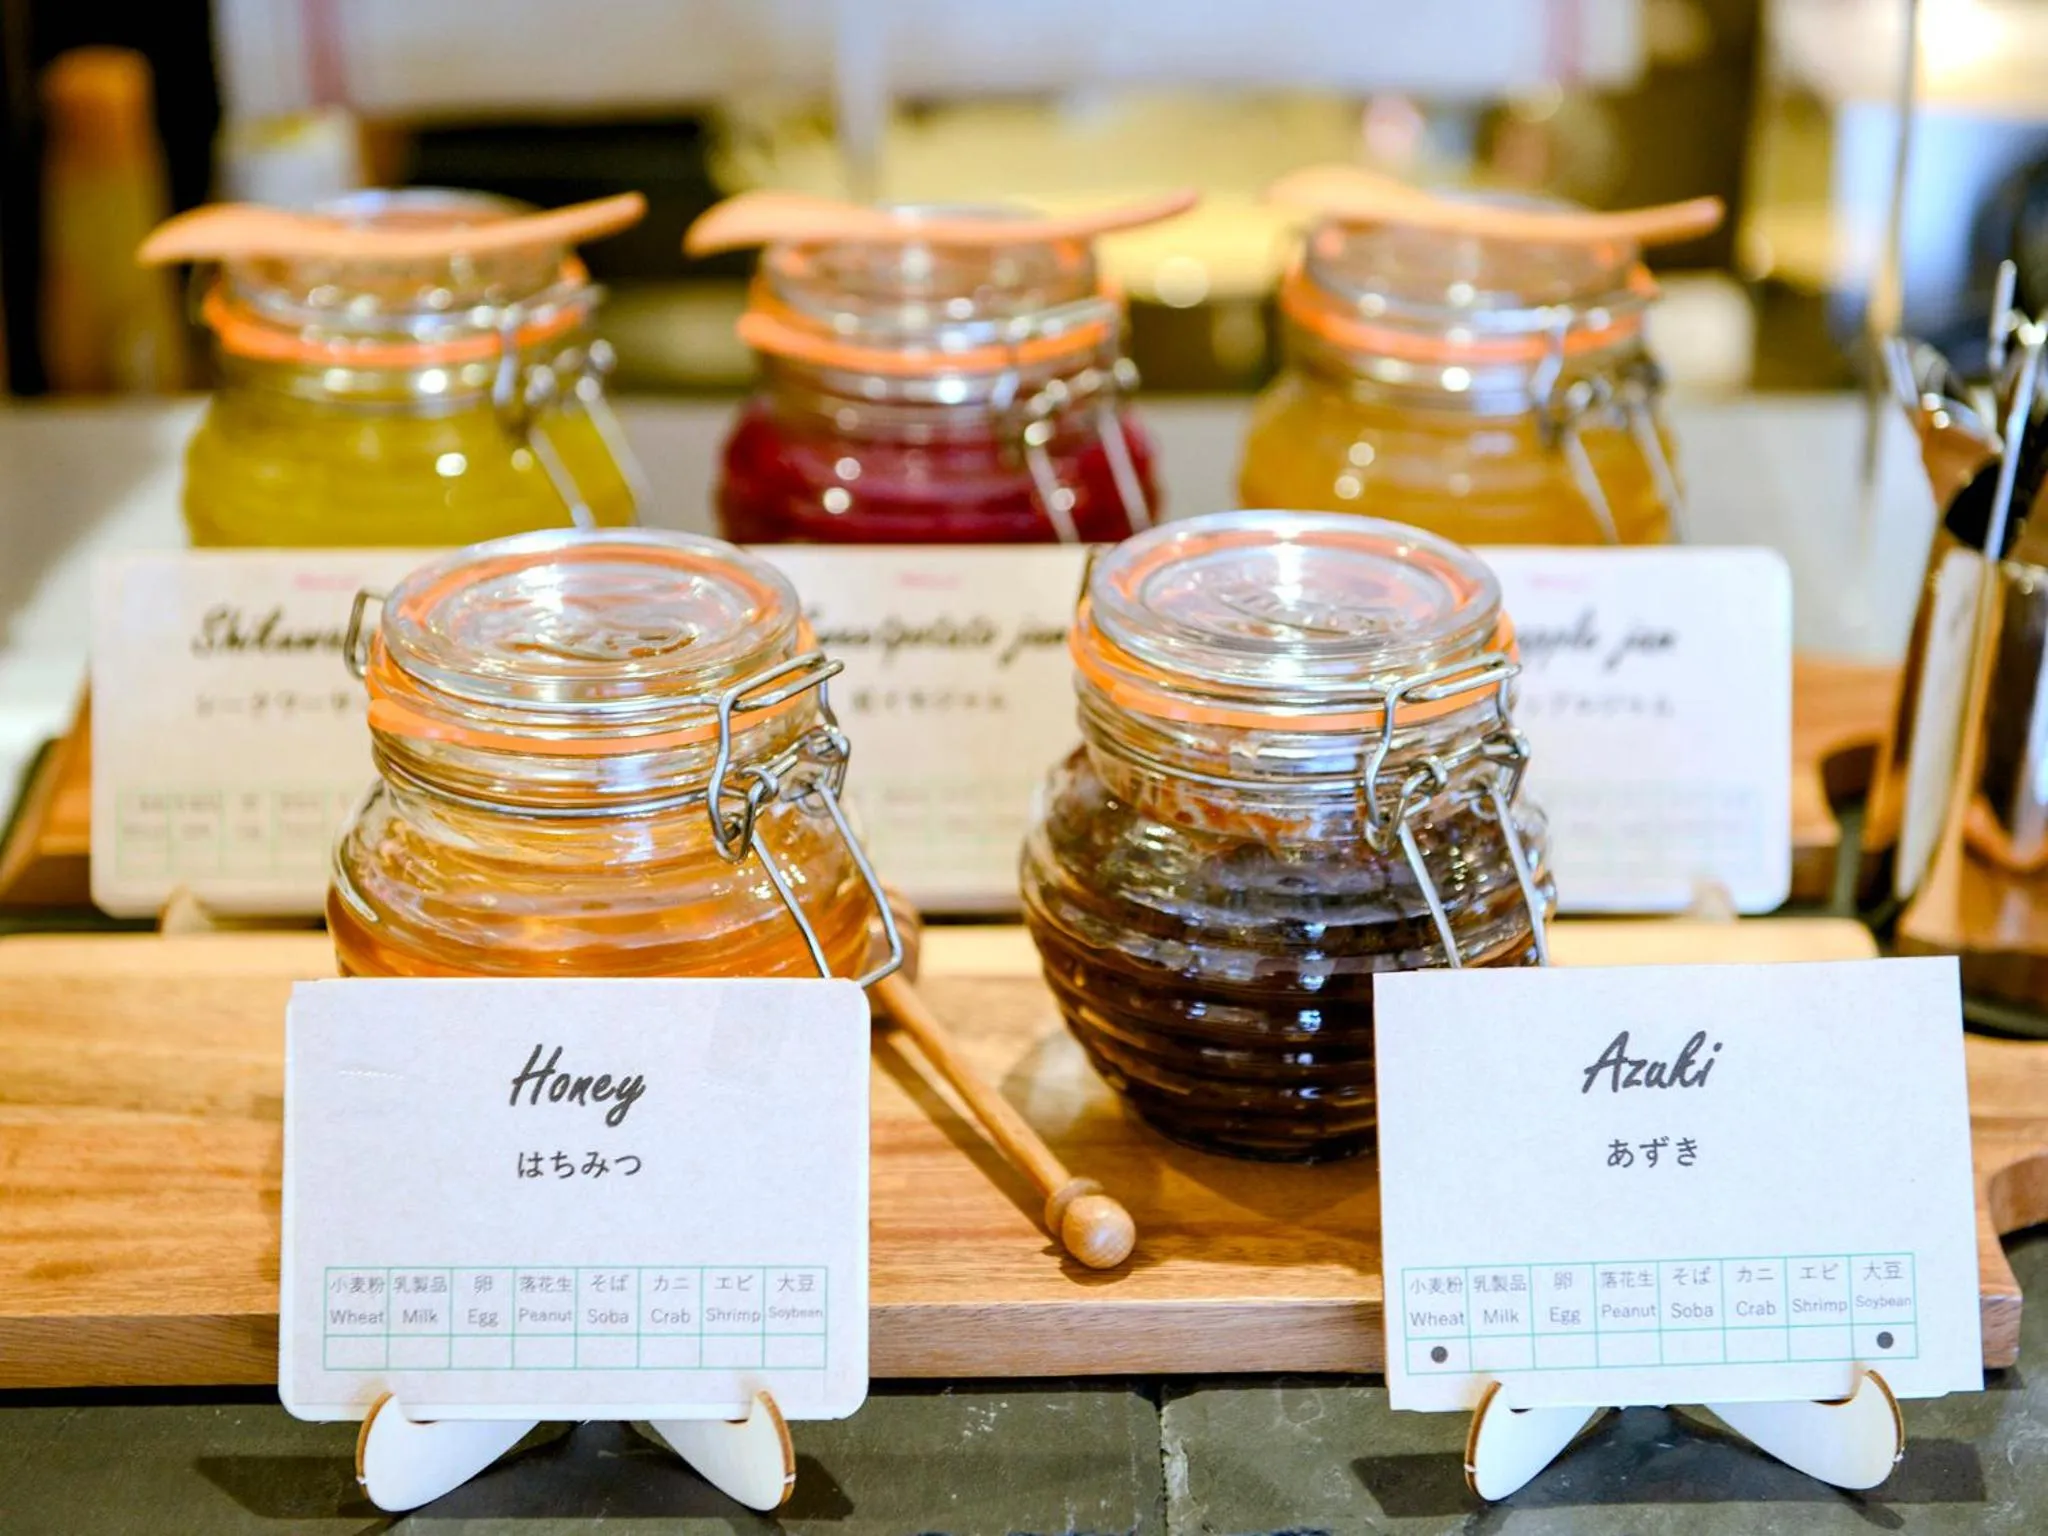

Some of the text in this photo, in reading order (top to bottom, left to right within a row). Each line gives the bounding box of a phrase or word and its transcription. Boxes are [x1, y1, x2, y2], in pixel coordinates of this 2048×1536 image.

[1580, 1029, 1724, 1095] Azuki
[508, 1042, 647, 1129] Honey
[516, 1150, 643, 1180] はちみつ
[1606, 1135, 1699, 1169] あずき
[330, 1274, 814, 1296] 小麦粉 乳製品 卵 落花生 そば カニ エビ 大豆
[1410, 1260, 1904, 1295] 小麦粉 乳製品 卵 落花生 そば カニ エビ 大豆
[329, 1305, 823, 1329] Wheat Milk Egg Peanut Soba Crab Shrimp Soybean
[1409, 1294, 1912, 1327] Wheat Milk Egg Peanut Soba Crab Shrimp Soybean
